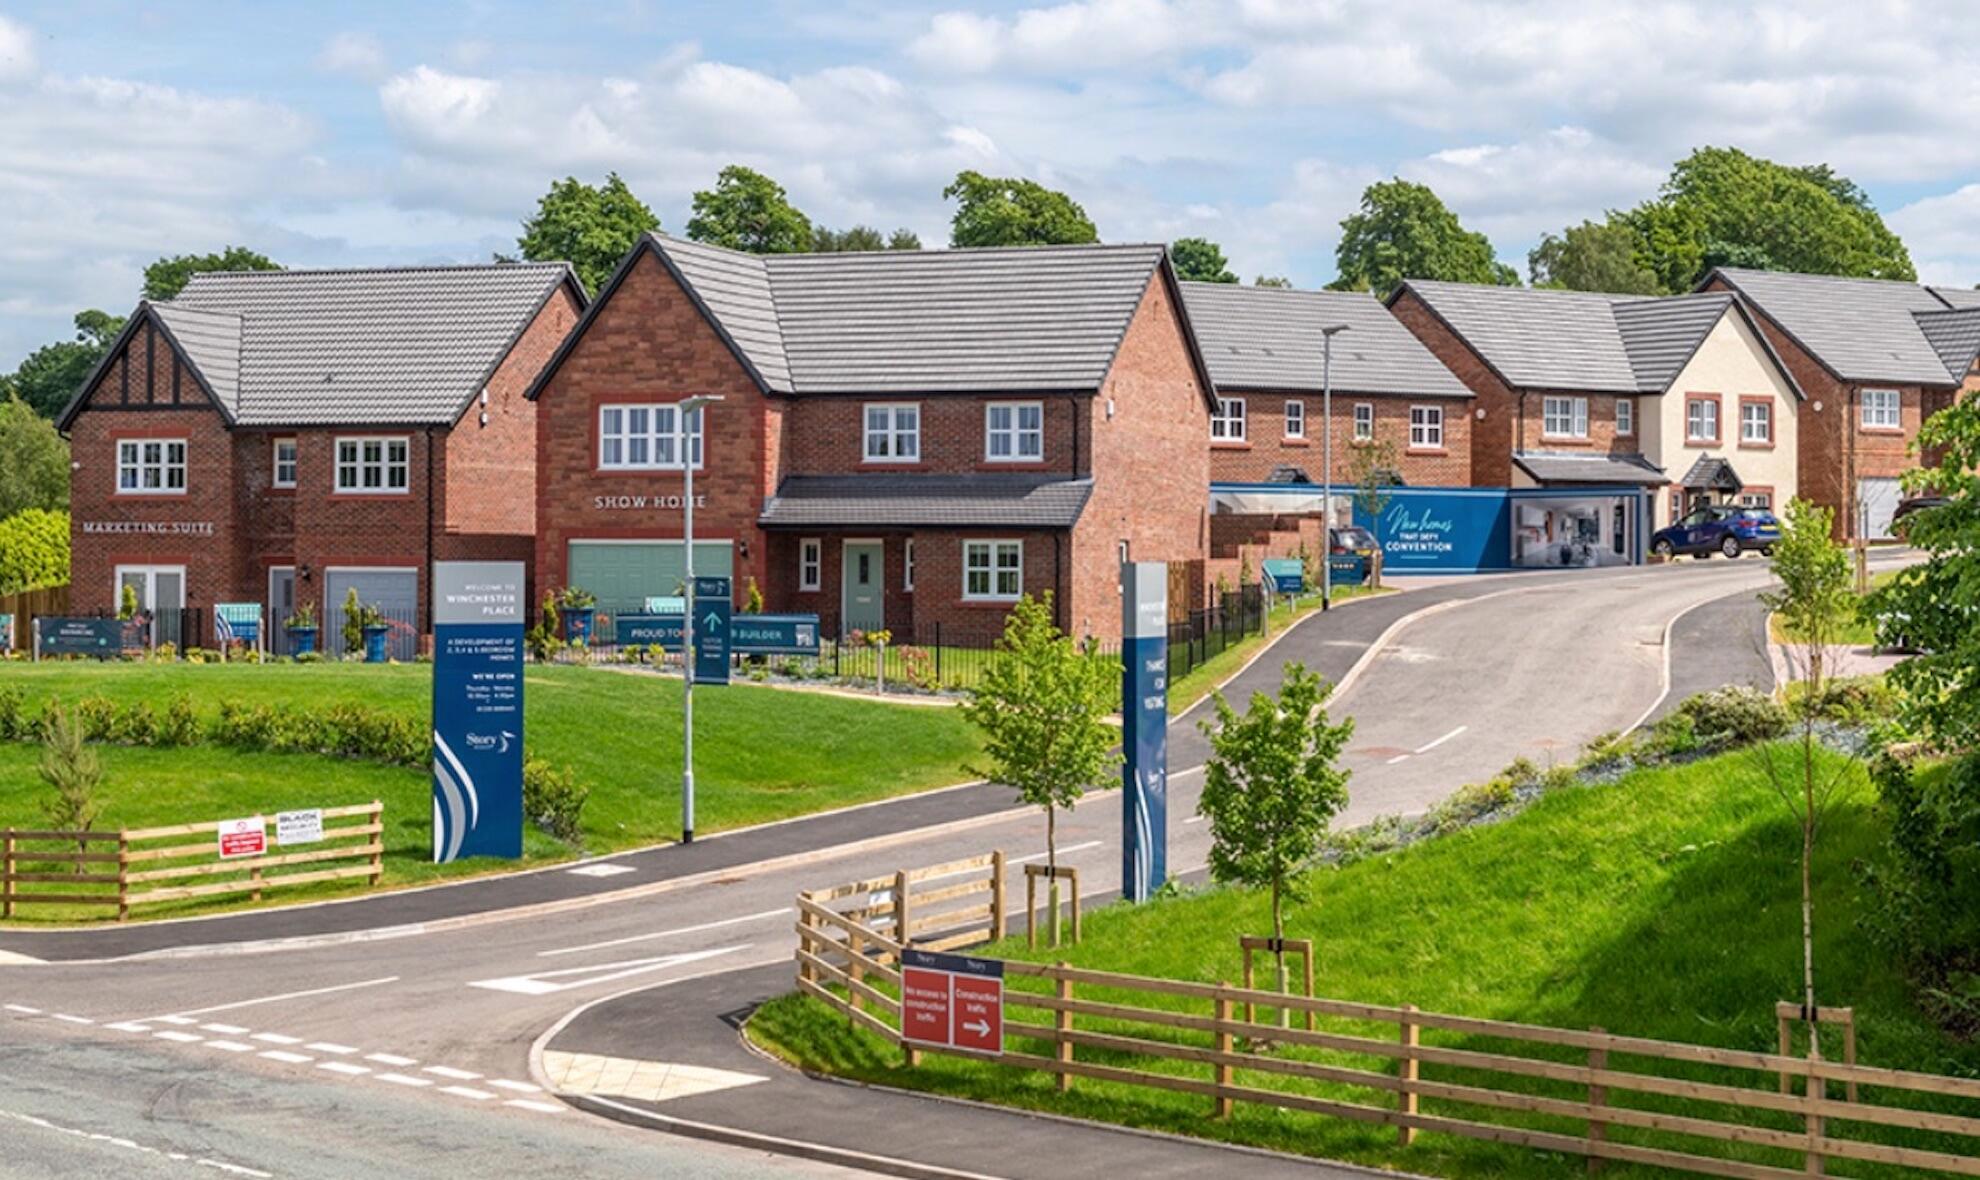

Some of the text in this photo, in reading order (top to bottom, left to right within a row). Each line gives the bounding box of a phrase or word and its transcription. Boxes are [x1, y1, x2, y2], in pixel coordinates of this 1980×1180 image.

[594, 495, 646, 509] SHOW
[83, 521, 214, 535] MARKETING SUITE
[1385, 541, 1453, 552] CONVENTION
[446, 595, 516, 603] WINCHESTER
[482, 606, 515, 615] PLACE
[631, 628, 664, 639] PROUD
[739, 629, 783, 640] BUILDER
[466, 732, 498, 746] Story
[955, 987, 998, 1003] Construction
[905, 999, 947, 1012] construction
